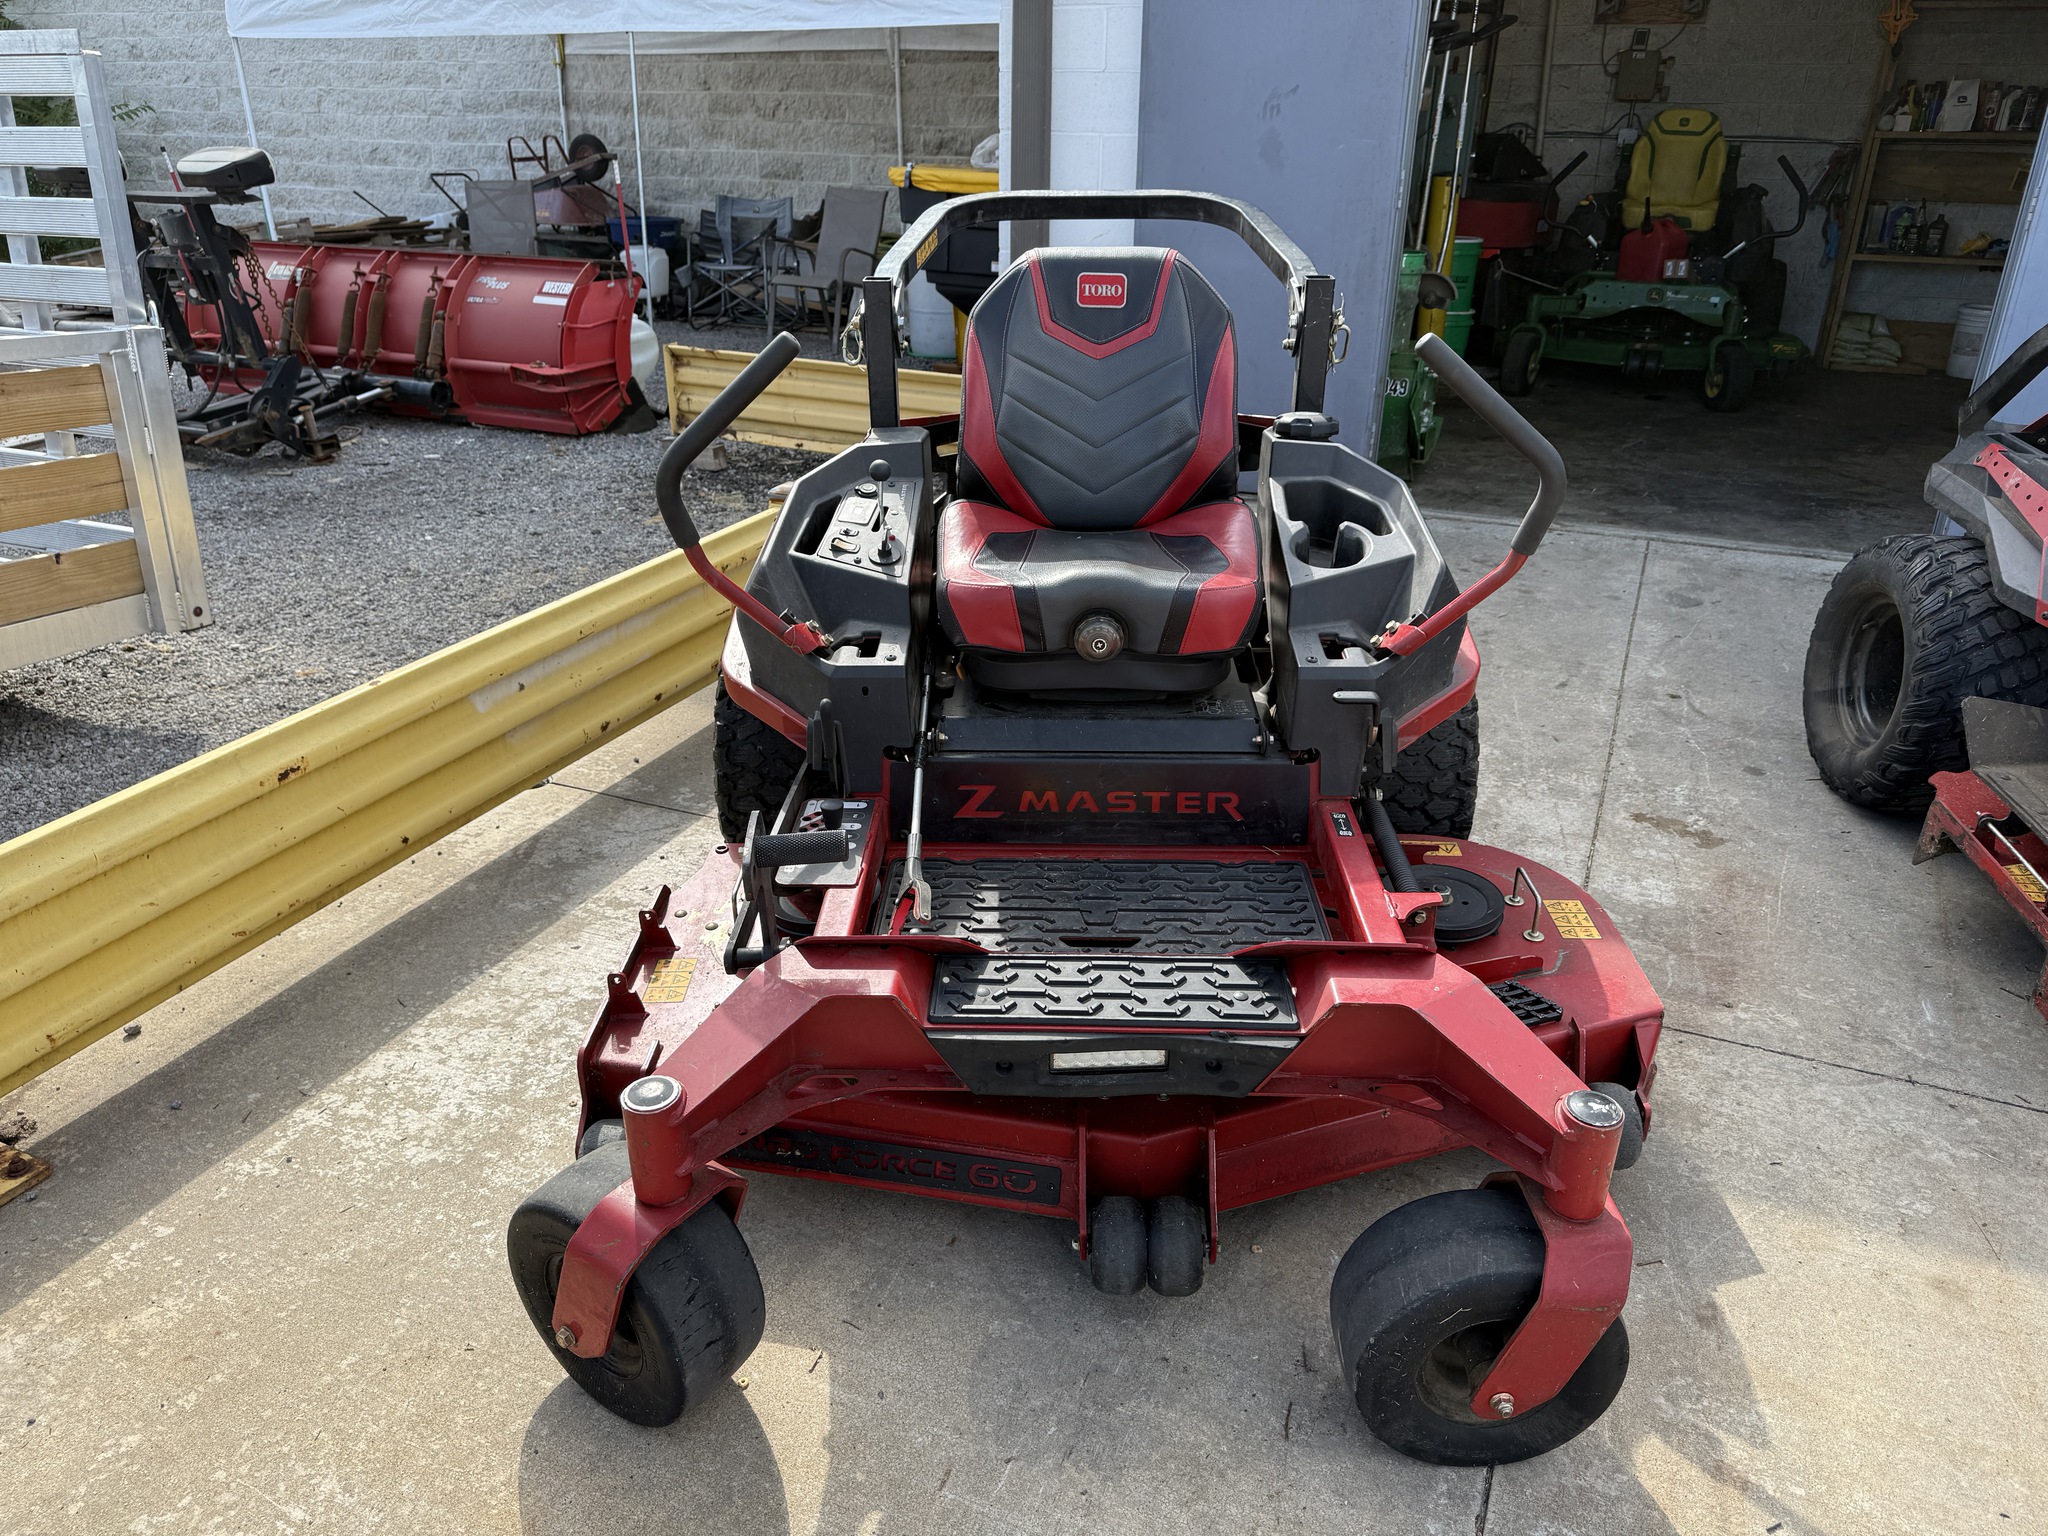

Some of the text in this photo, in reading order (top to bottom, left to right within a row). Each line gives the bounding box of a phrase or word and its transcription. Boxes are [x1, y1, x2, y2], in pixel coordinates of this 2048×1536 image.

[1081, 283, 1122, 298] TORO
[1385, 377, 1409, 397] 49
[952, 784, 1245, 821] Z MASTER
[829, 1144, 957, 1181] FORCE
[967, 1163, 1037, 1194] 60
